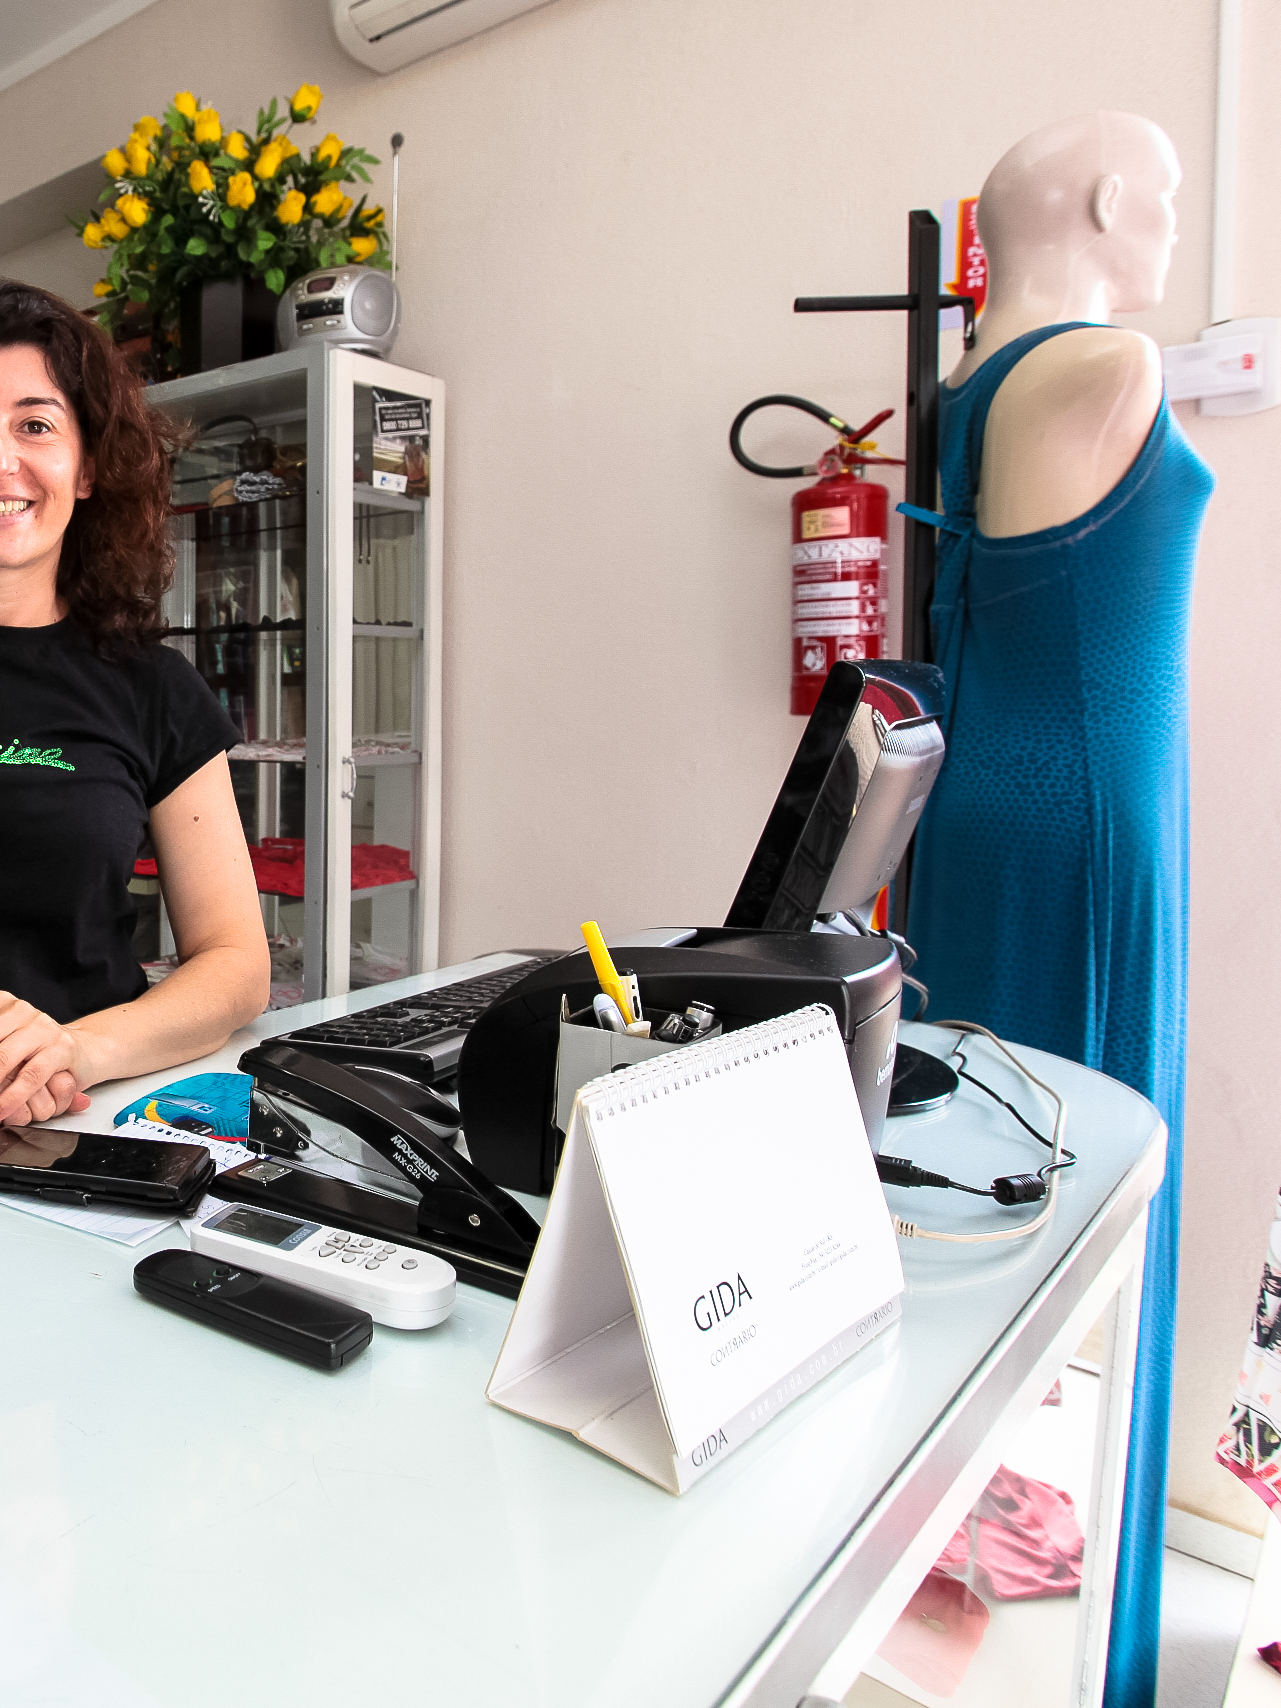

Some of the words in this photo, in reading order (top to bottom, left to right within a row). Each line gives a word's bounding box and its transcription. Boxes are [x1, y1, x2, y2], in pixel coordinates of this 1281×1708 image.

[390, 1134, 440, 1182] MAXPRINT
[392, 1151, 422, 1180] MX-G26
[694, 1271, 753, 1331] GIDA
[691, 1427, 729, 1468] GIDA
